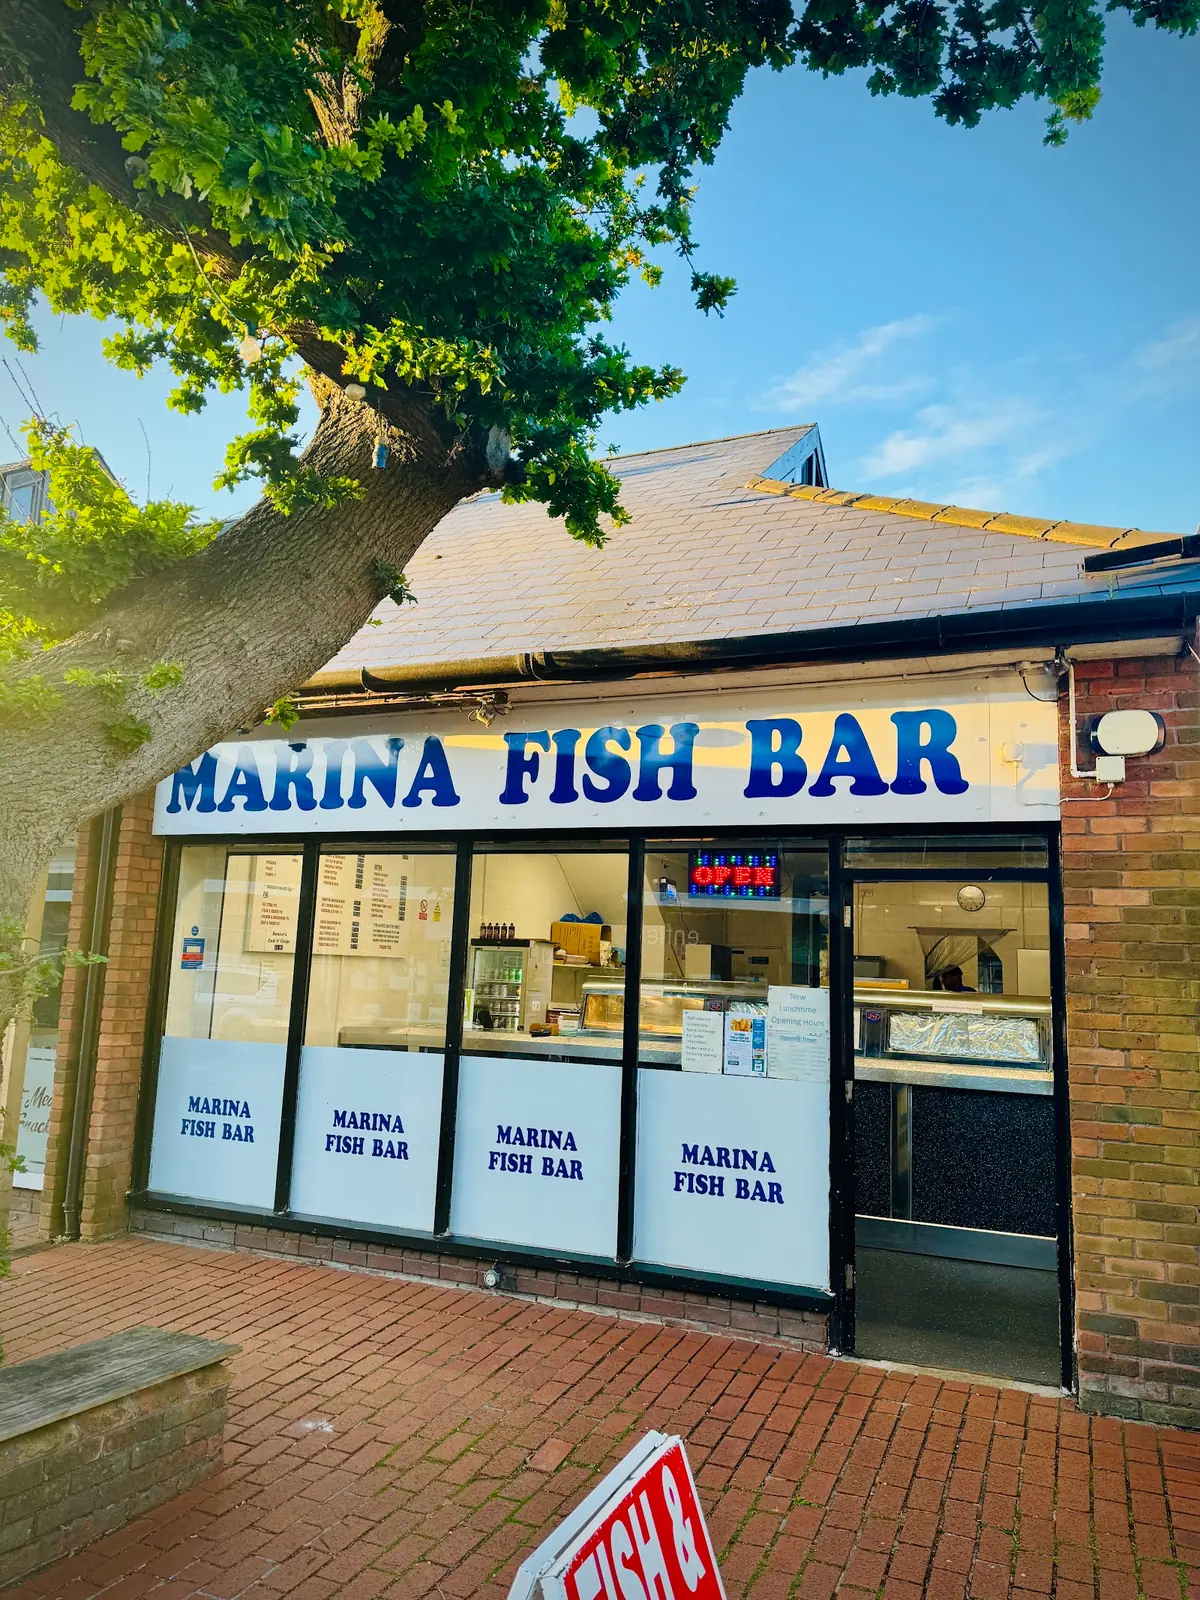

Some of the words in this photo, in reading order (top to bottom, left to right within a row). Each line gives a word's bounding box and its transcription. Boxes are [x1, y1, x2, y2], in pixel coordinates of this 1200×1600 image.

[166, 736, 461, 814] MARINA
[499, 721, 700, 806] FISH
[743, 708, 970, 799] BAR
[692, 865, 777, 886] OPEN
[779, 1004, 817, 1014] Lunchtime
[789, 992, 807, 1001] New
[771, 1016, 802, 1027] Opening
[803, 1018, 825, 1027] Hours
[780, 1034, 801, 1043] Opening
[802, 1036, 817, 1044] Times
[188, 1095, 251, 1119] MARINA
[180, 1118, 215, 1139] FISH
[222, 1122, 255, 1144] BAR
[332, 1109, 404, 1134] MARINA
[324, 1133, 365, 1156] FISH
[371, 1137, 410, 1161] BAR
[496, 1124, 578, 1152] MARINA
[488, 1150, 533, 1174] FISH
[541, 1156, 584, 1181] BAR
[681, 1143, 777, 1173] MARINA
[673, 1170, 725, 1197] FISH
[735, 1177, 785, 1205] BAR
[661, 1464, 707, 1593] &
